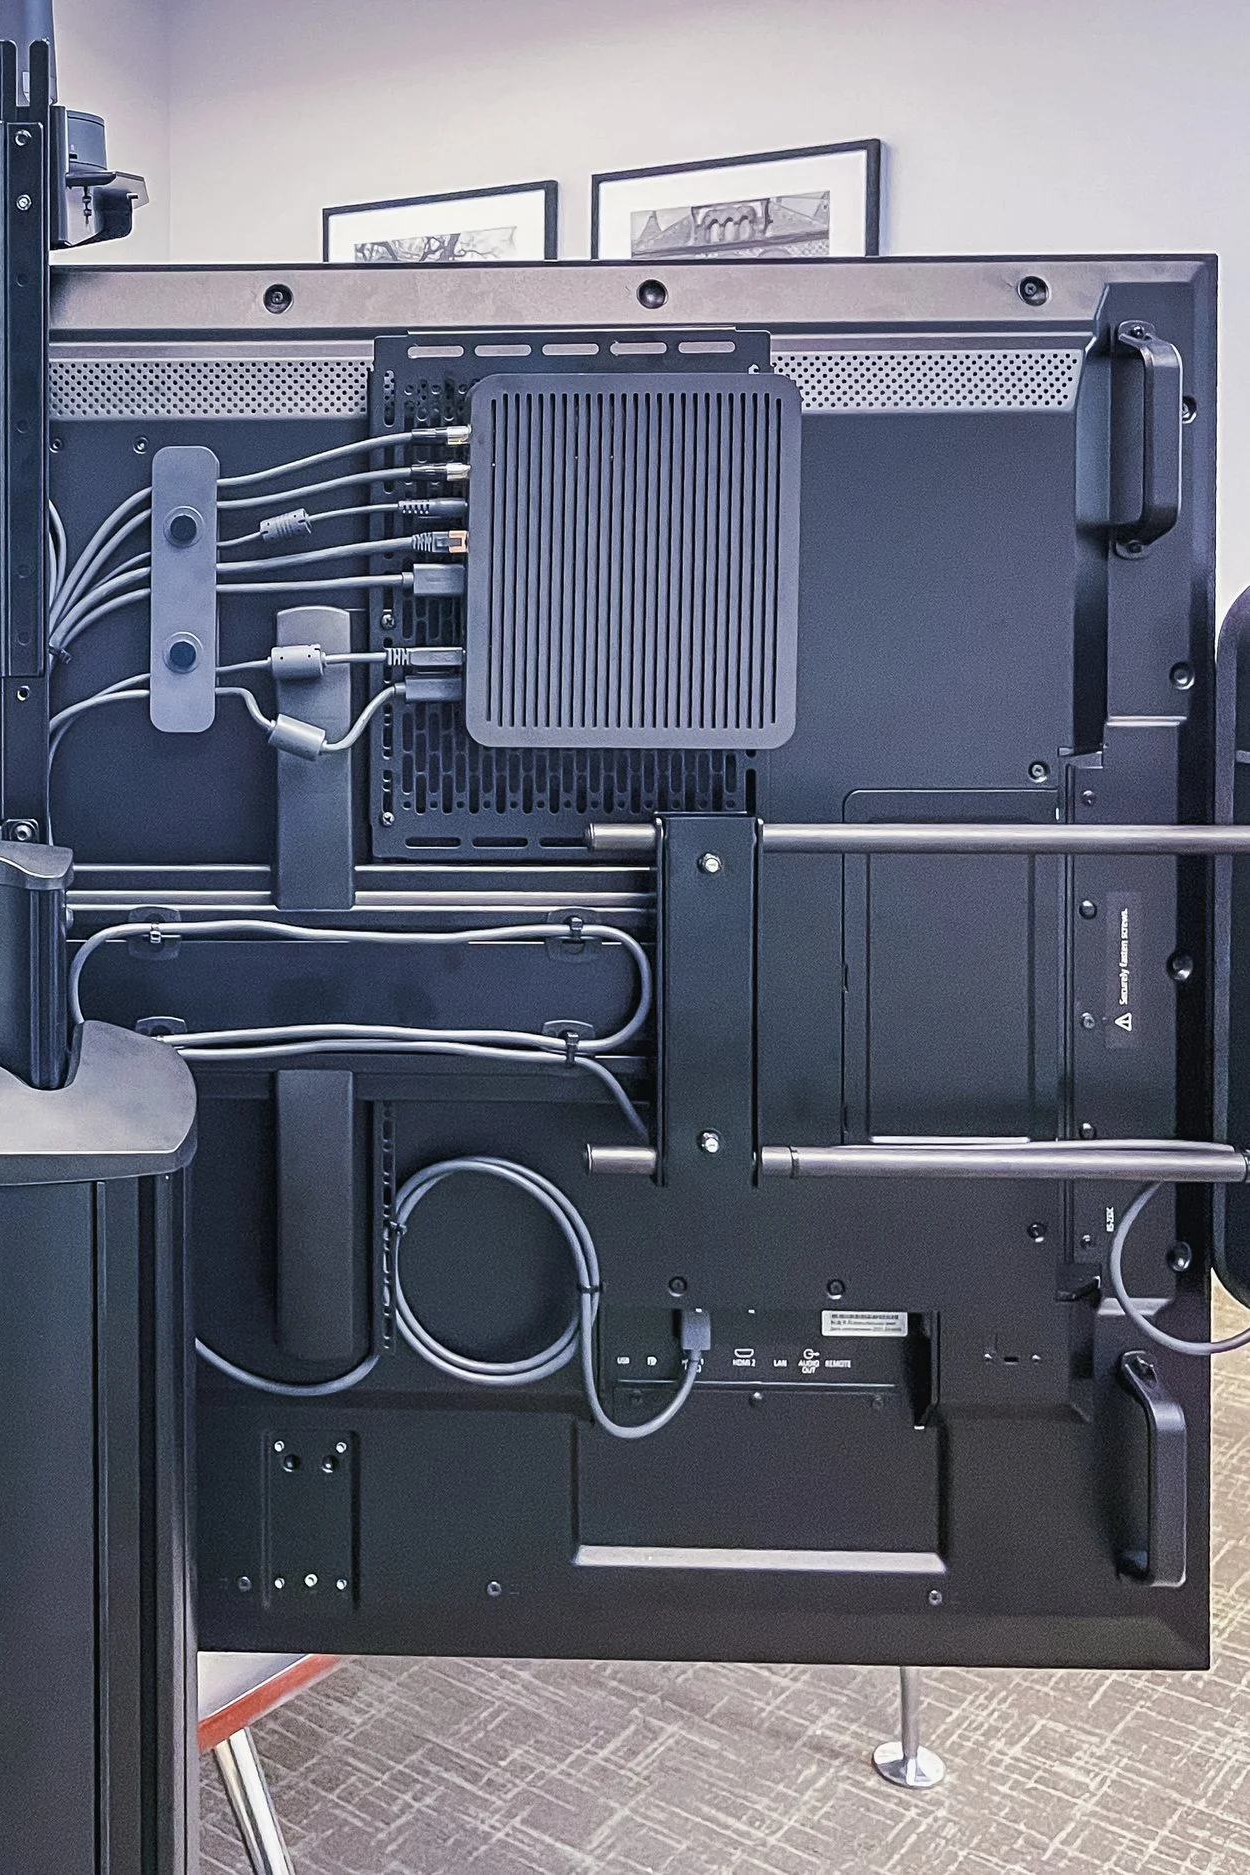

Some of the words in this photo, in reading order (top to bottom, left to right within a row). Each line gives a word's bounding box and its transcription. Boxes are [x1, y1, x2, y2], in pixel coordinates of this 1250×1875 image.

[1119, 940, 1129, 967] fasten
[1119, 968, 1130, 1005] Securely
[732, 1359, 750, 1367] HDMI
[751, 1359, 756, 1367] 2
[773, 1359, 787, 1367] LAN
[798, 1359, 819, 1367] AUDIO
[825, 1360, 851, 1368] REMOTE
[801, 1366, 816, 1374] OUT
